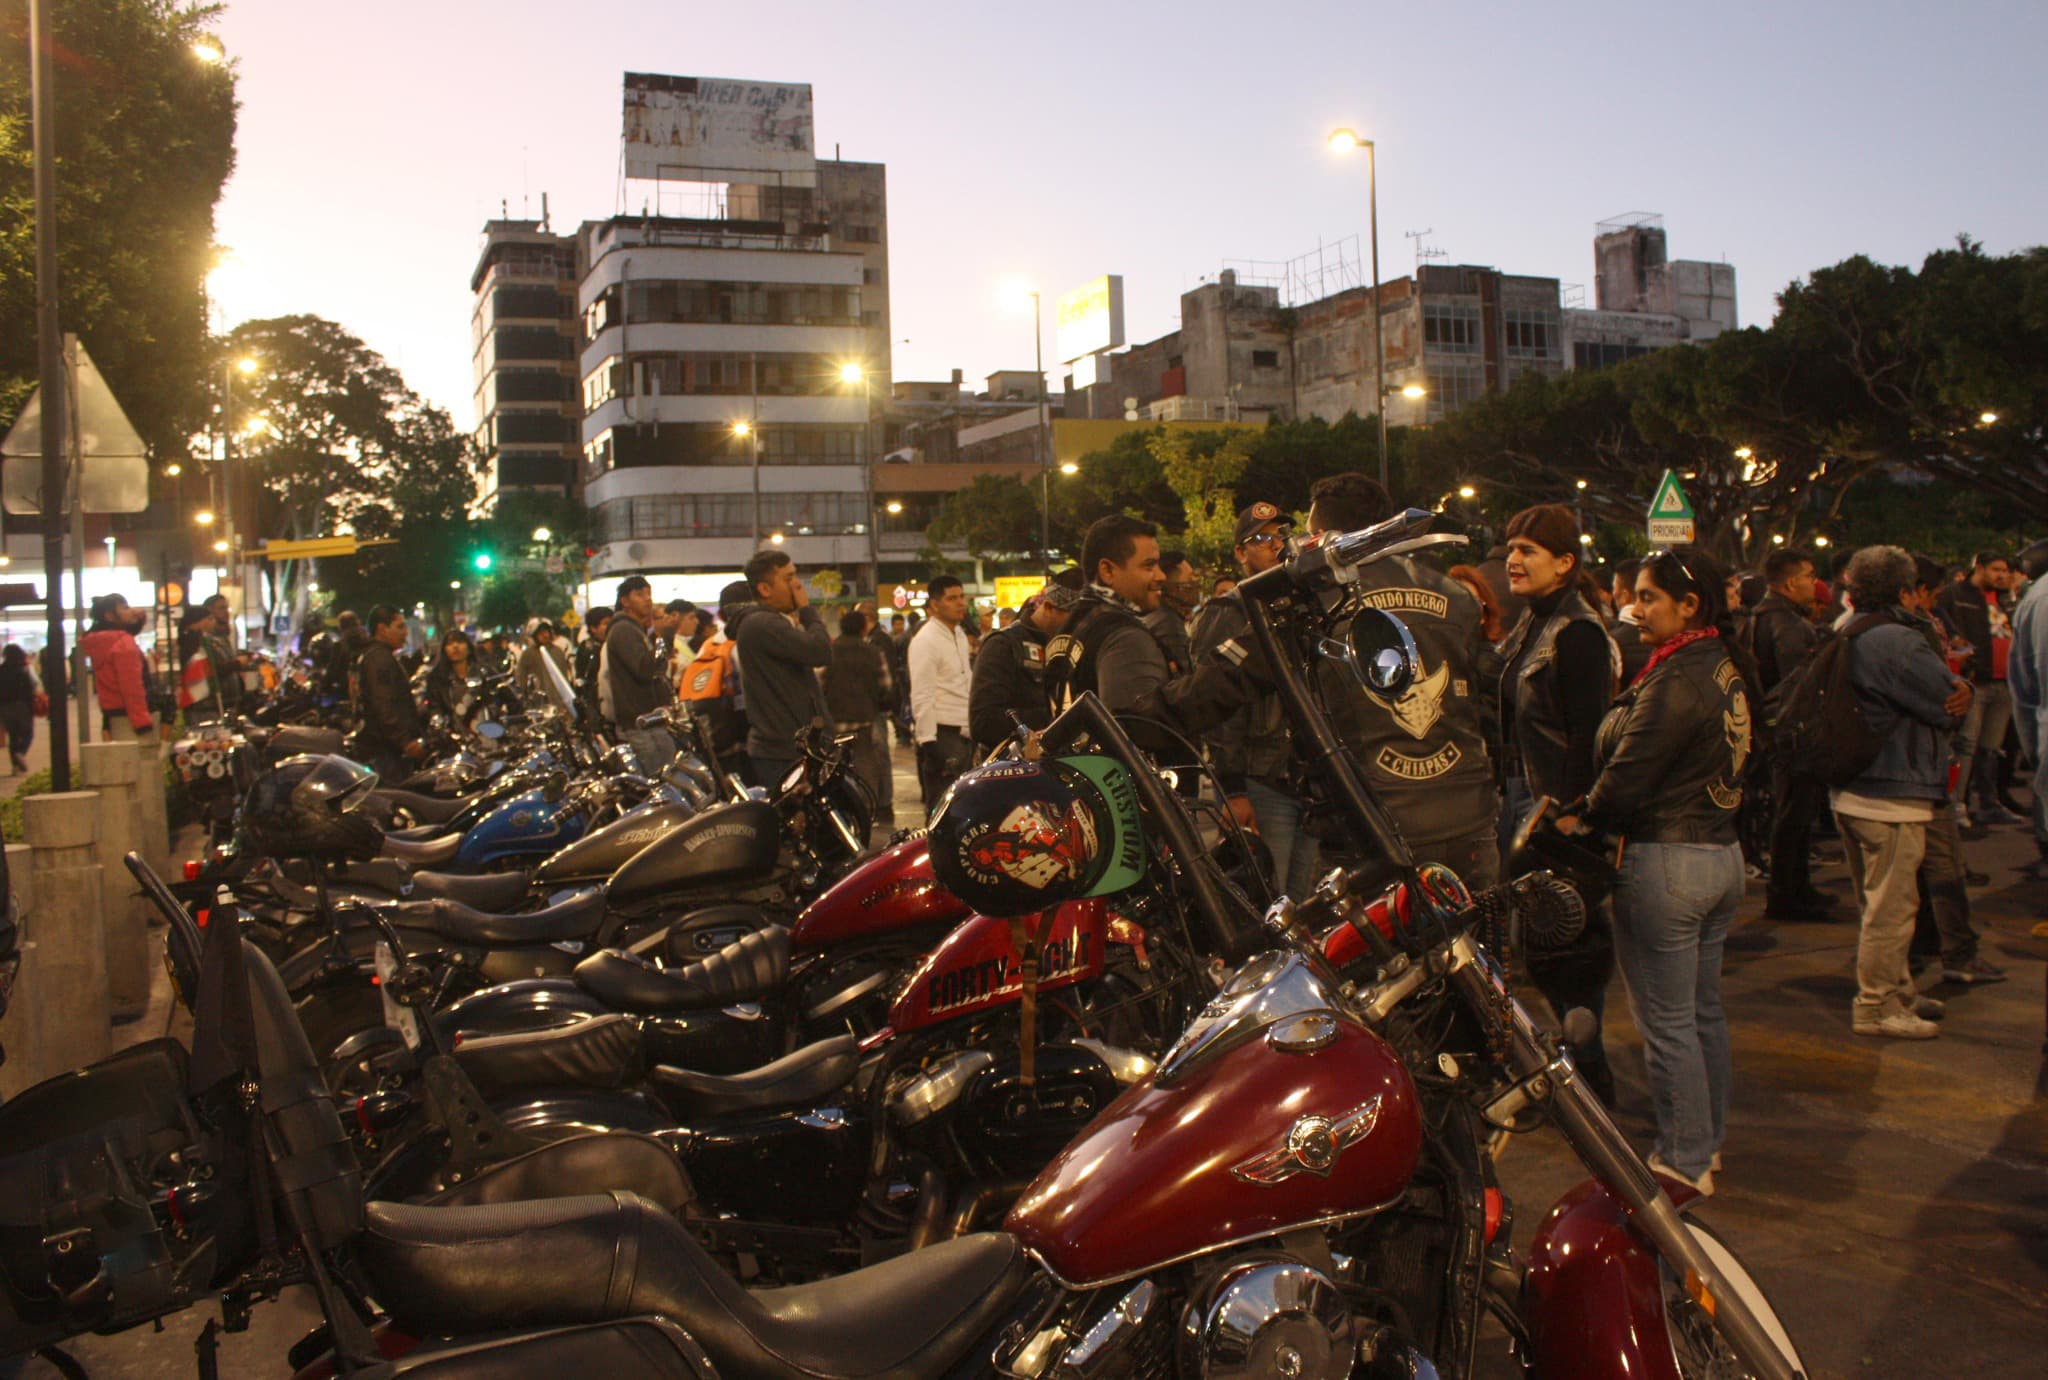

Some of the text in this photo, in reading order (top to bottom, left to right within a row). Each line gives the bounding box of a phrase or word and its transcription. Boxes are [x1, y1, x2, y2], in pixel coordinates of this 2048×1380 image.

[1362, 591, 1444, 614] NDIDO NEGRO
[1391, 753, 1449, 777] CHIAPAS
[1102, 767, 1140, 872] CUSTOM
[958, 823, 999, 884] CHOPPERS
